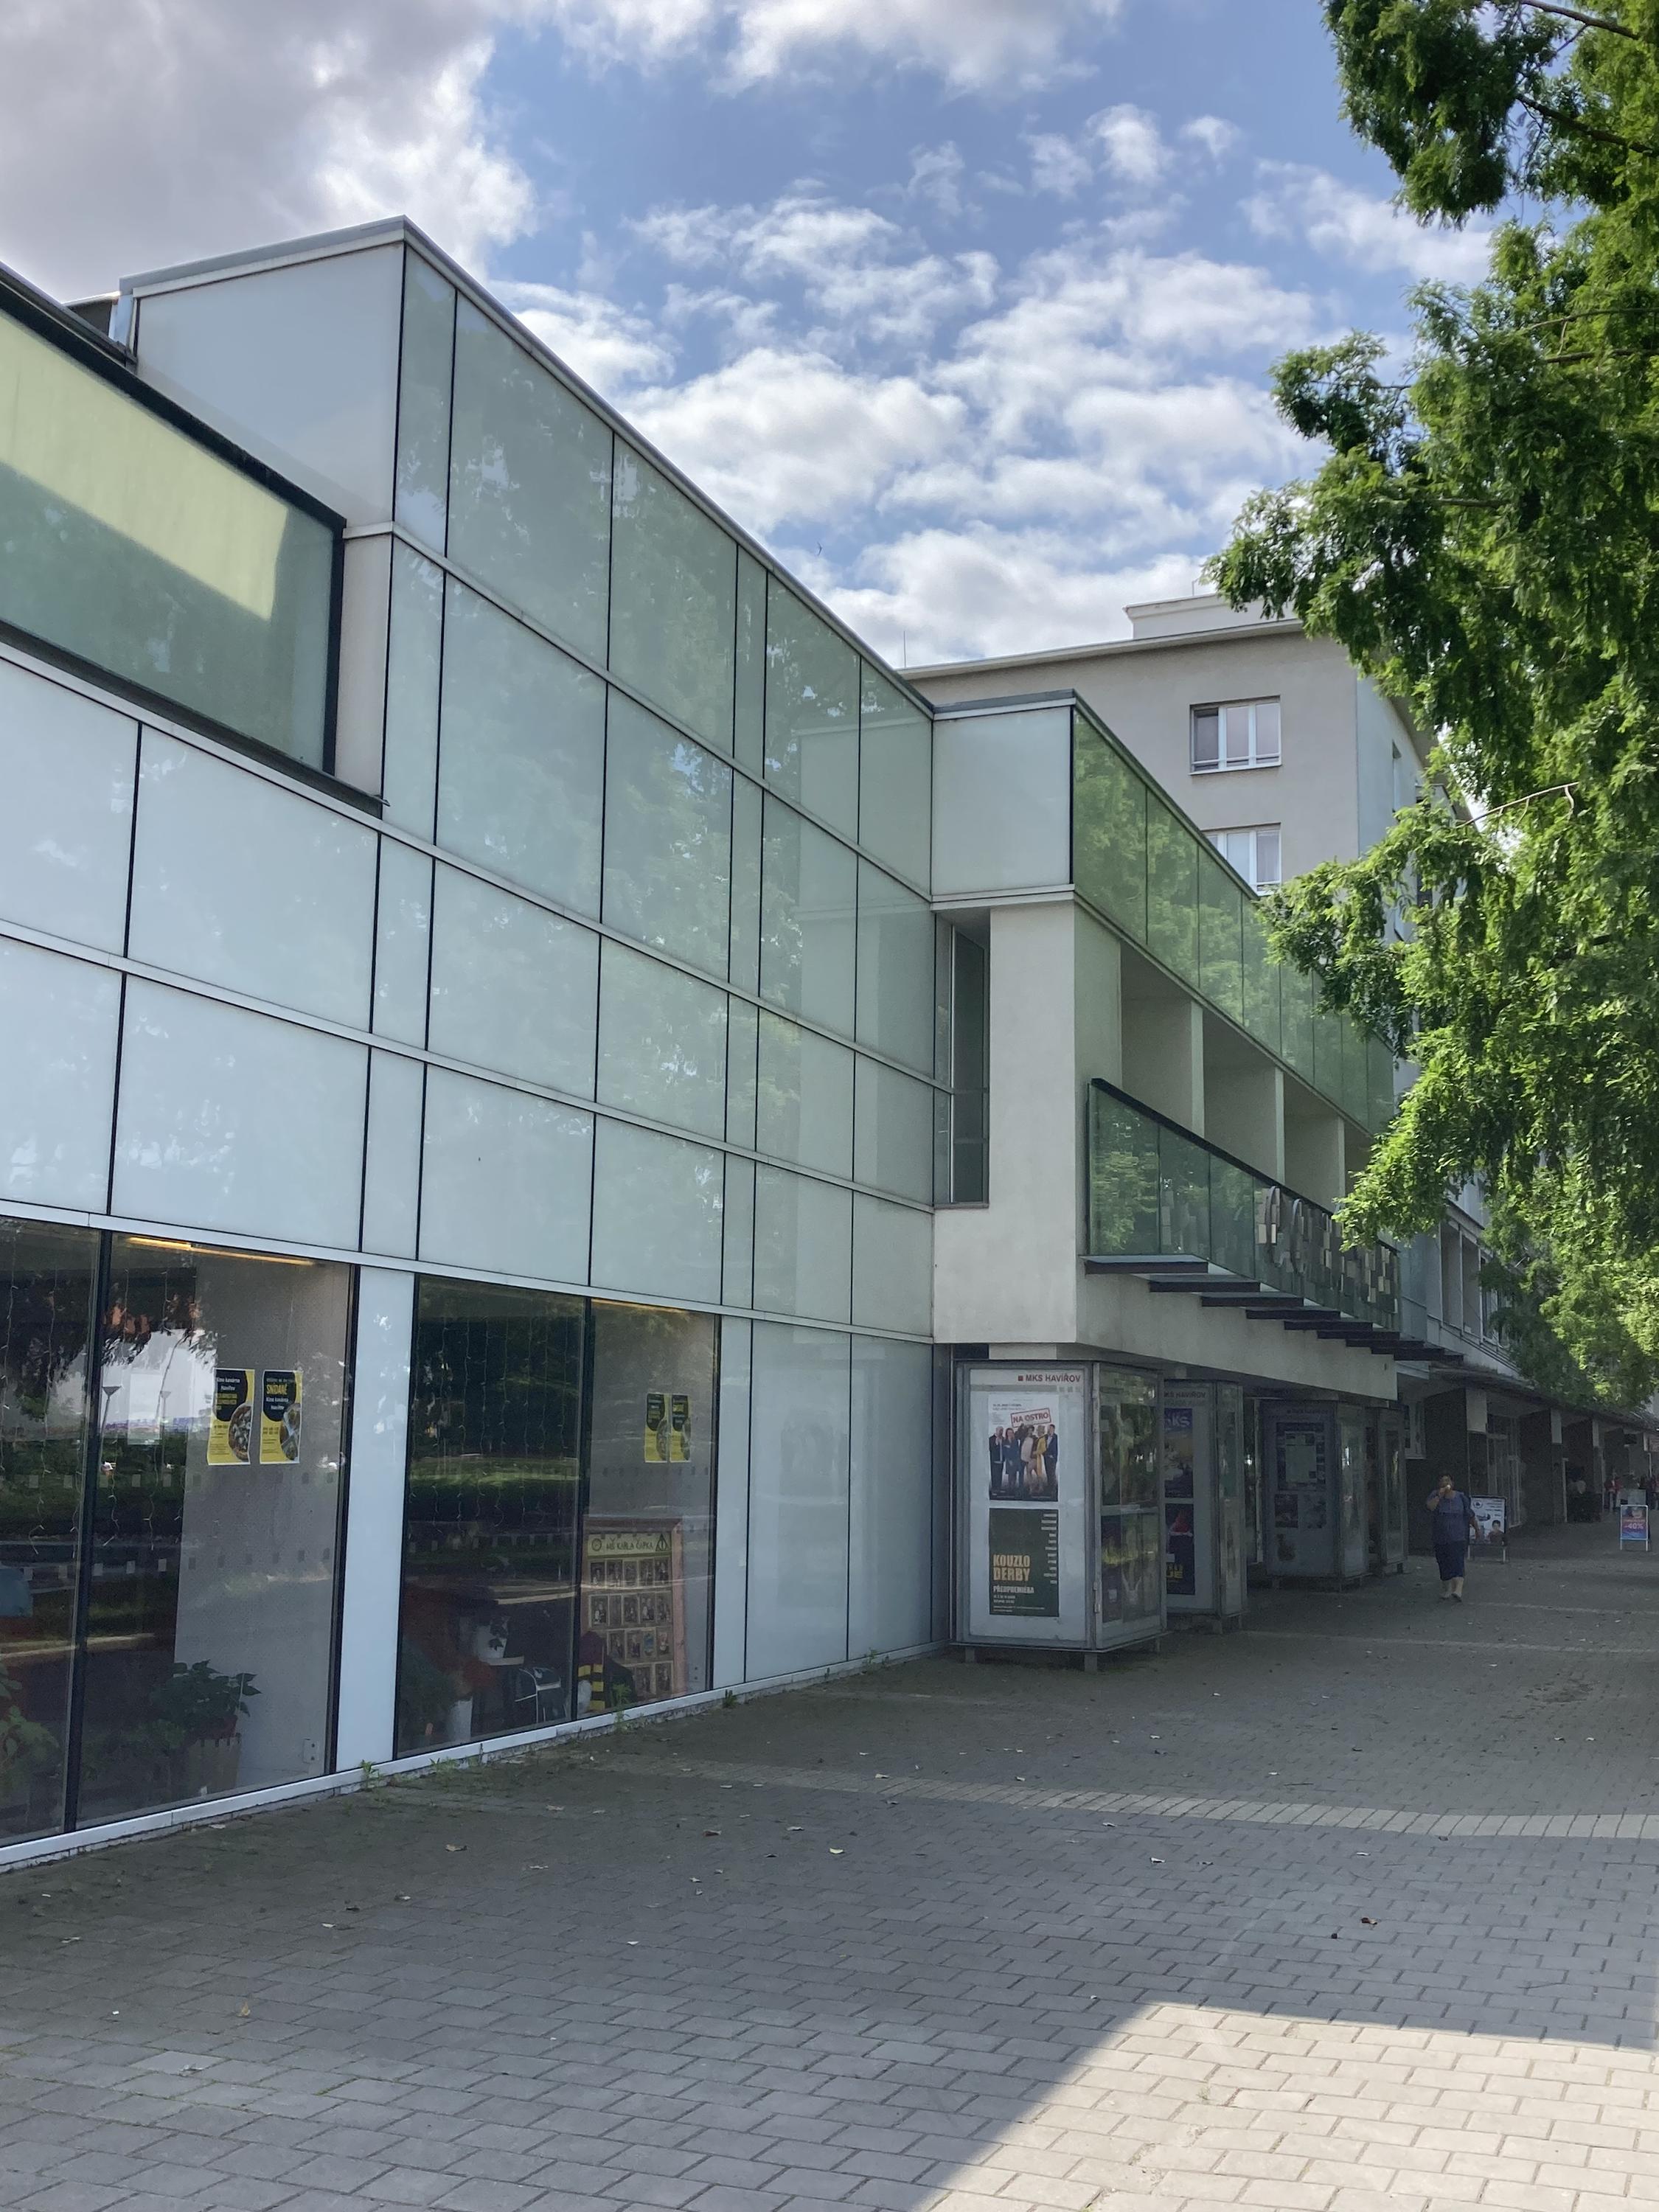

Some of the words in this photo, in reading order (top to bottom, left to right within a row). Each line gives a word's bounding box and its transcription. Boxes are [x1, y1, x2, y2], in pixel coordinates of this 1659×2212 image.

[1025, 1374, 1043, 1382] MKS
[1045, 1373, 1081, 1382] HAVÍŘOV
[1024, 1412, 1048, 1422] OSTRO
[993, 1554, 1030, 1567] KOUZLO
[993, 1568, 1030, 1581] DERBY
